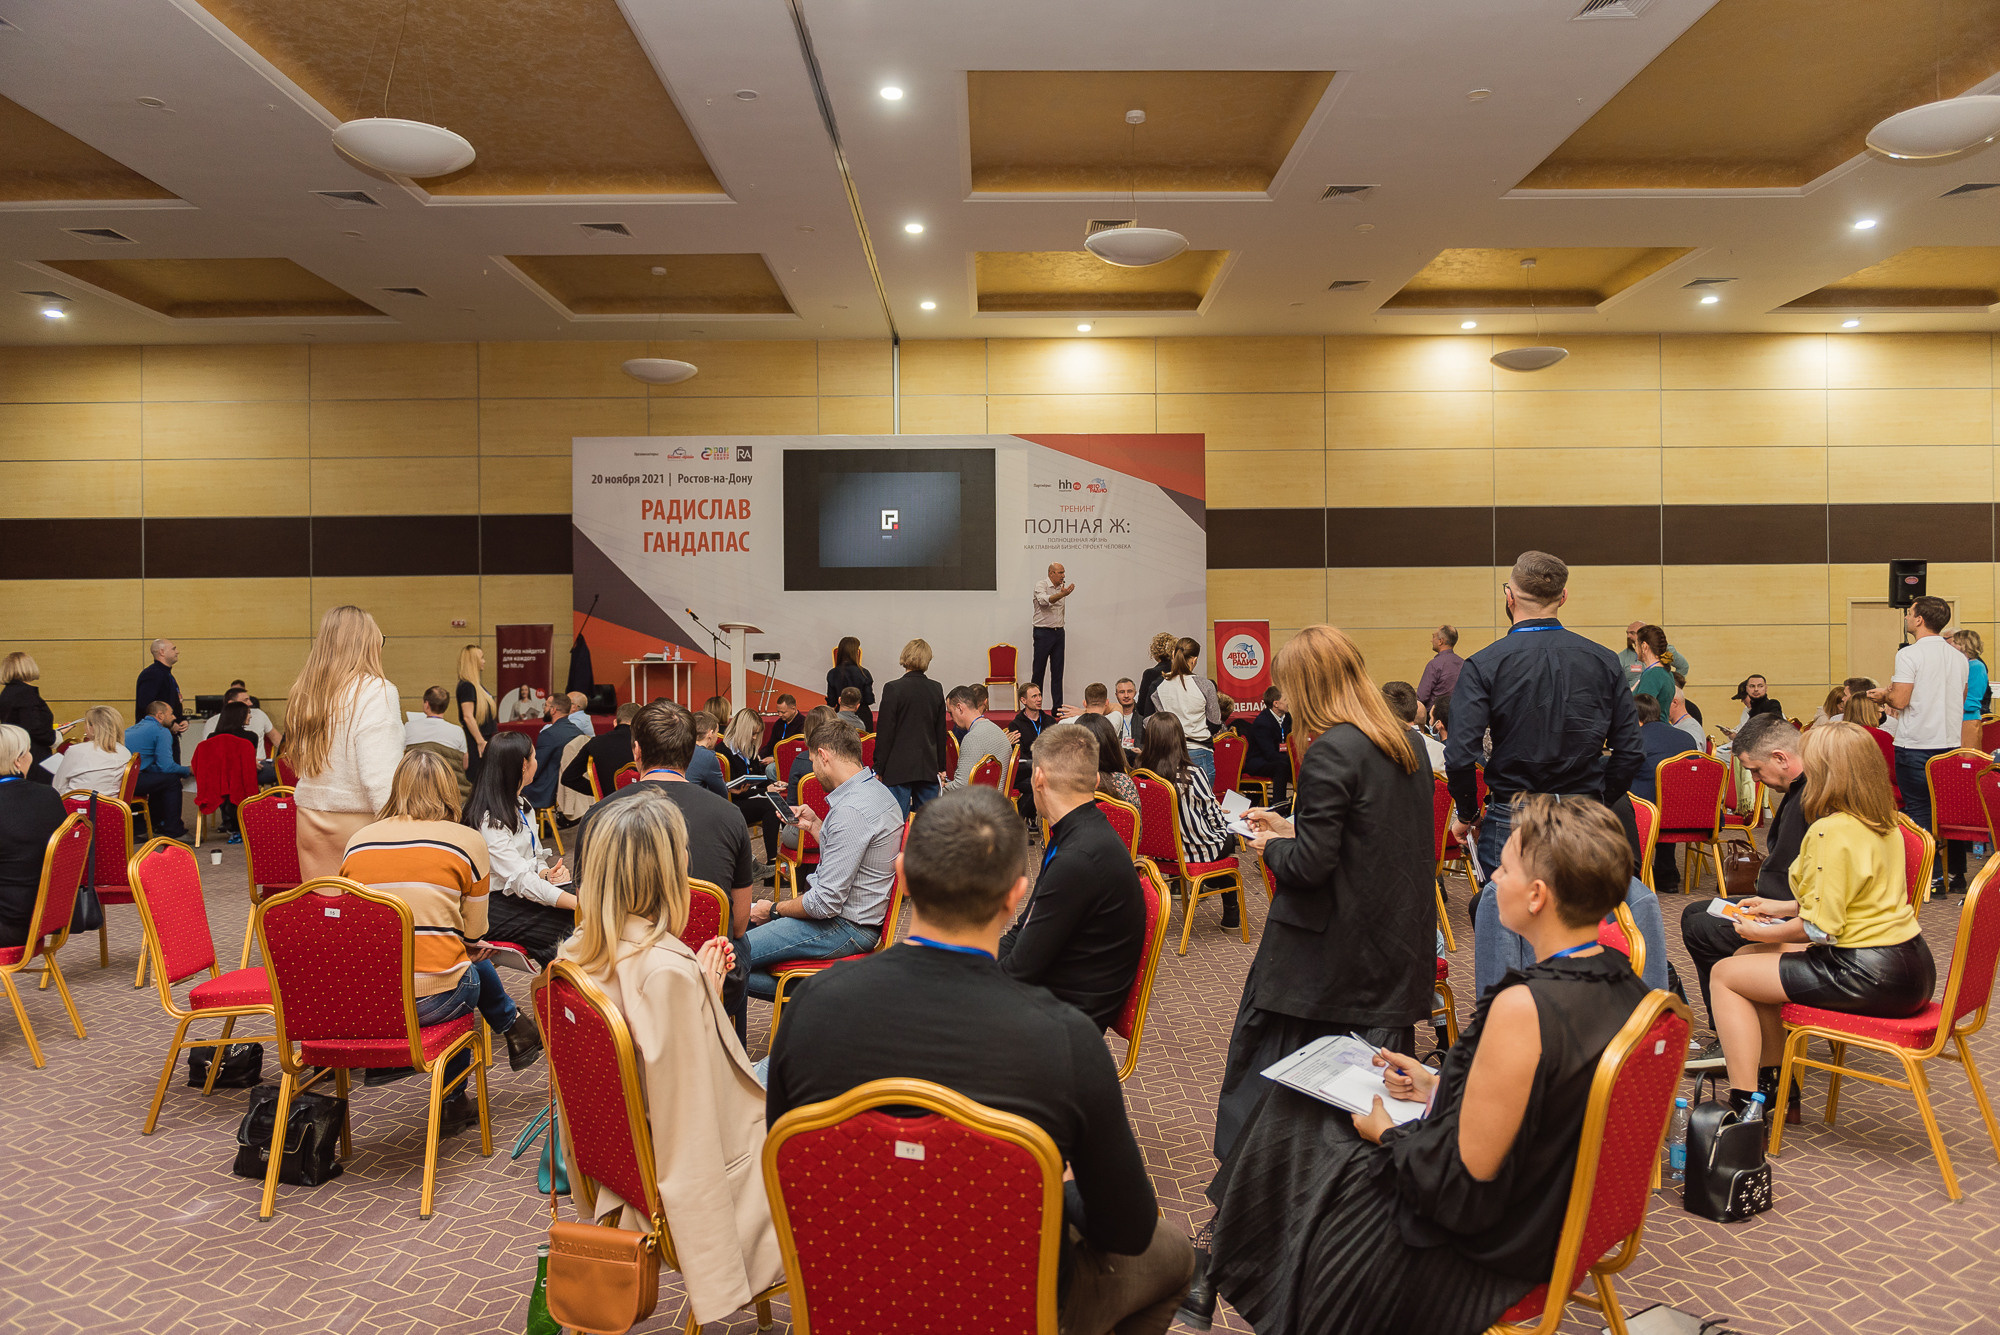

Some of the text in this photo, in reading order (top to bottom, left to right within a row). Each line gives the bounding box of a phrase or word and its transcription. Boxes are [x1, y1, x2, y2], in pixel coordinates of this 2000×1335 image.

[737, 448, 751, 460] RA
[591, 473, 664, 486] 20 ноября 2021
[677, 473, 753, 486] Ростов-на-Дону
[641, 499, 751, 524] РАДИСЛАВ
[1025, 518, 1130, 534] ПОЛНАЯ Ж:
[643, 531, 750, 556] ГАНДАПАС
[1227, 652, 1247, 660] АВТО
[1233, 699, 1267, 712] ДЕЛАЙ
